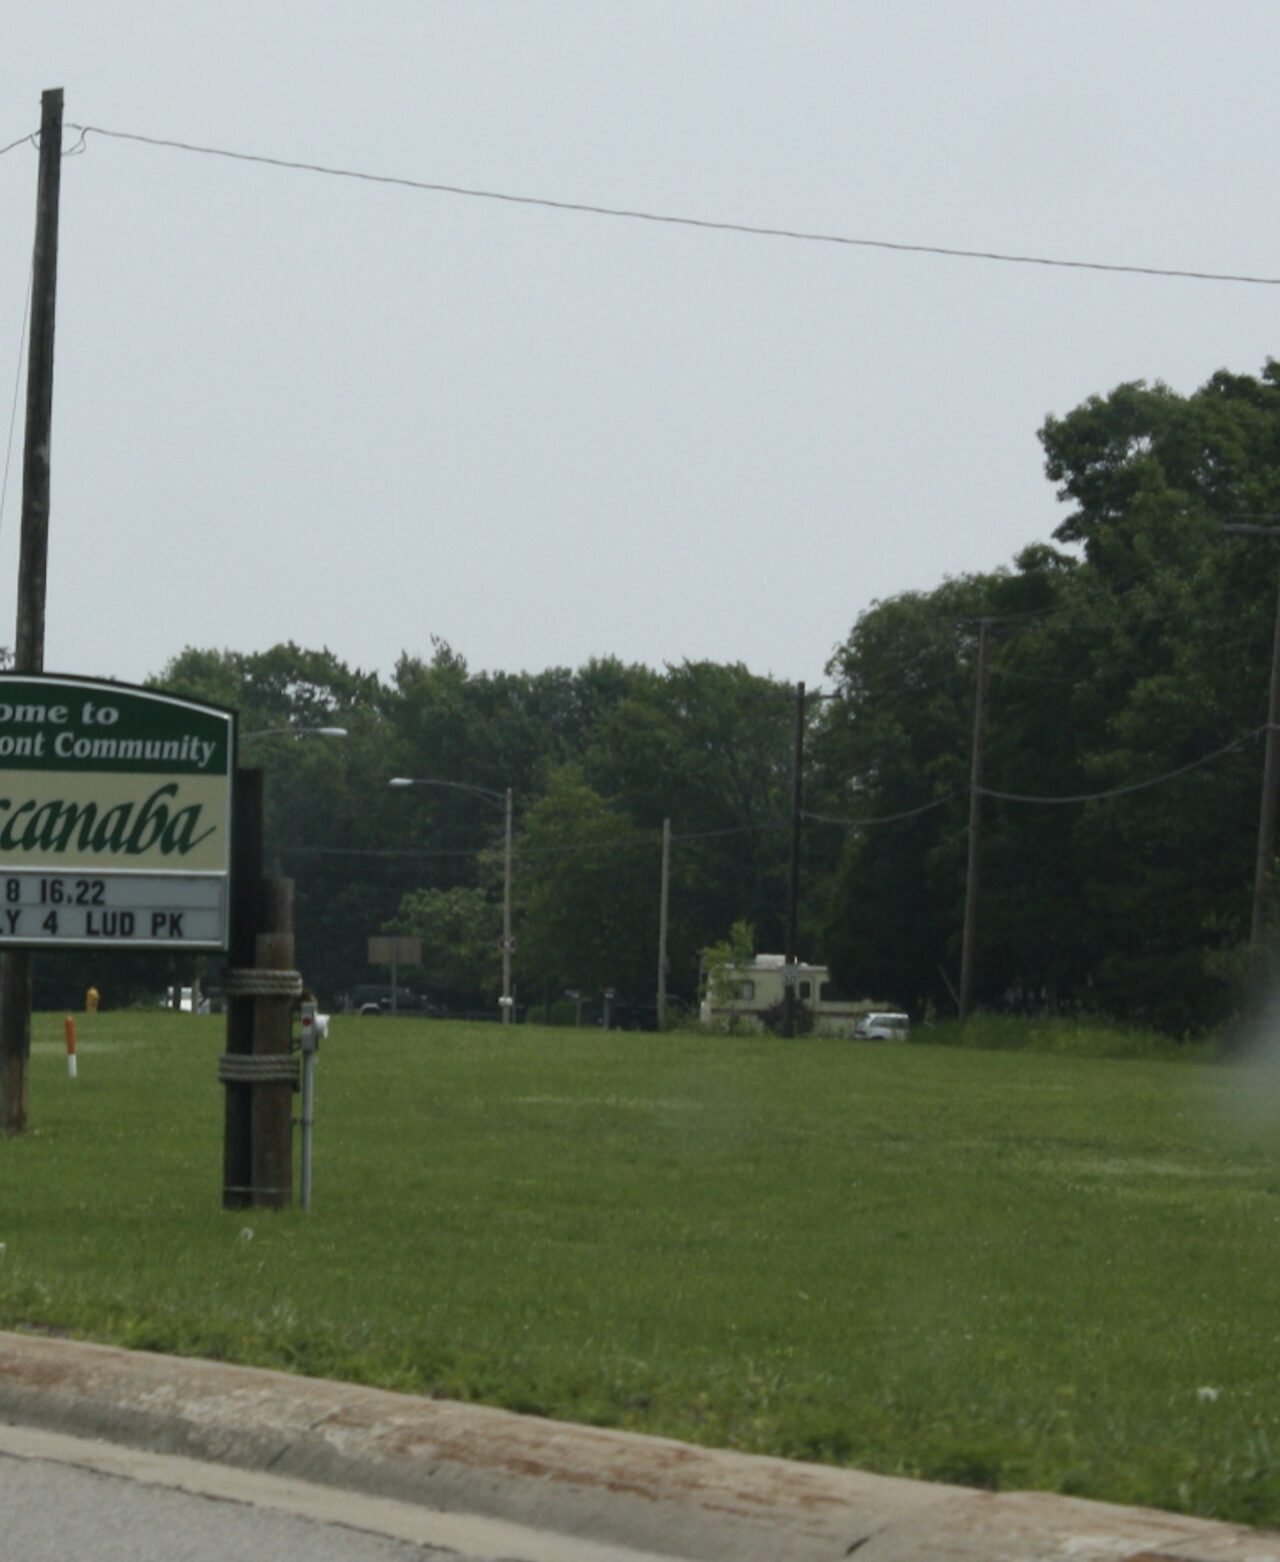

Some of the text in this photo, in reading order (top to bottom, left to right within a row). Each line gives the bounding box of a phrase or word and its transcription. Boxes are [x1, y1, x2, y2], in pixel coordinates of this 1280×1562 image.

[81, 700, 120, 725] to
[54, 733, 217, 768] Community
[5, 878, 21, 903] 8
[42, 910, 58, 936] 4
[85, 911, 135, 938] LUD
[151, 912, 184, 938] PK
